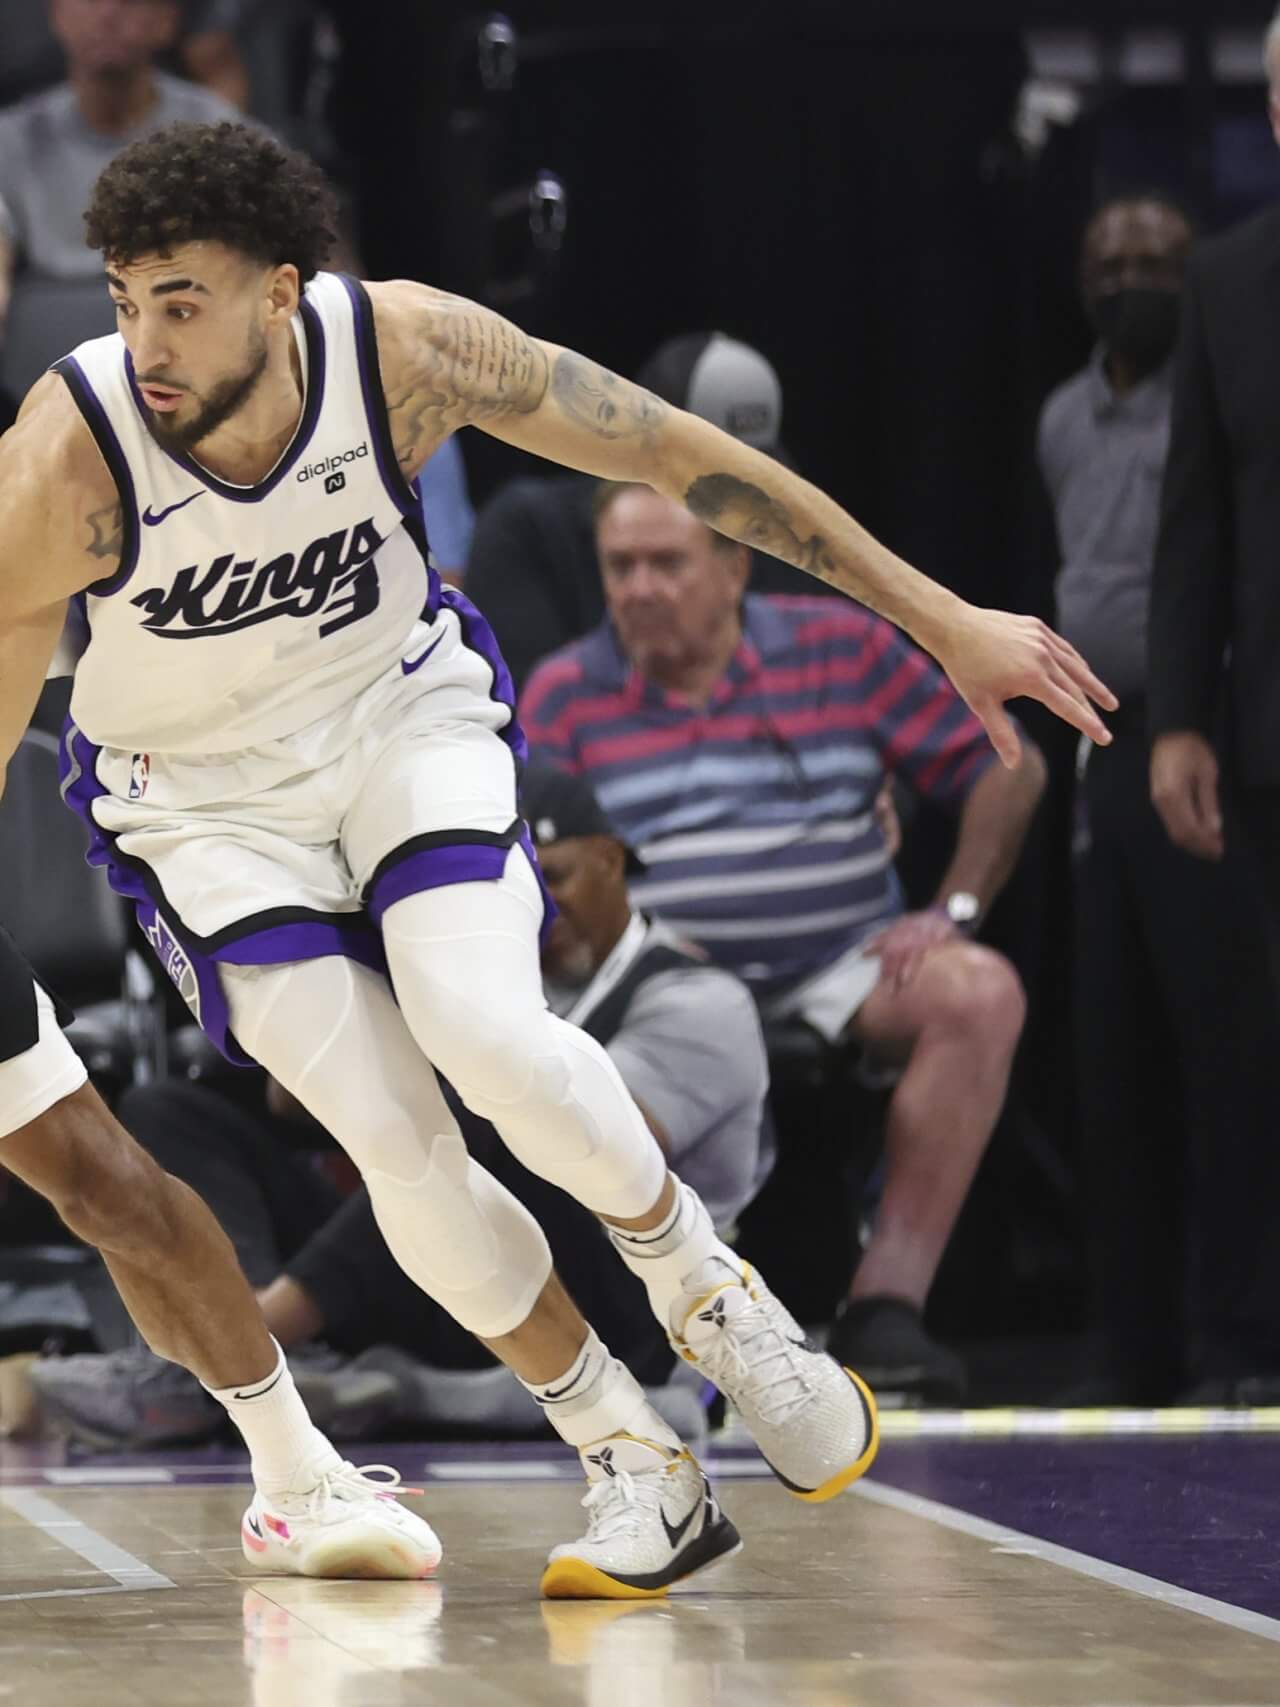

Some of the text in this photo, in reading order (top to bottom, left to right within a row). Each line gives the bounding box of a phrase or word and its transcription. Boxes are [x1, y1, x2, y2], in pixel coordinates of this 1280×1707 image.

[296, 441, 368, 483] dialpad
[129, 516, 391, 639] Kings
[318, 558, 380, 639] 3
